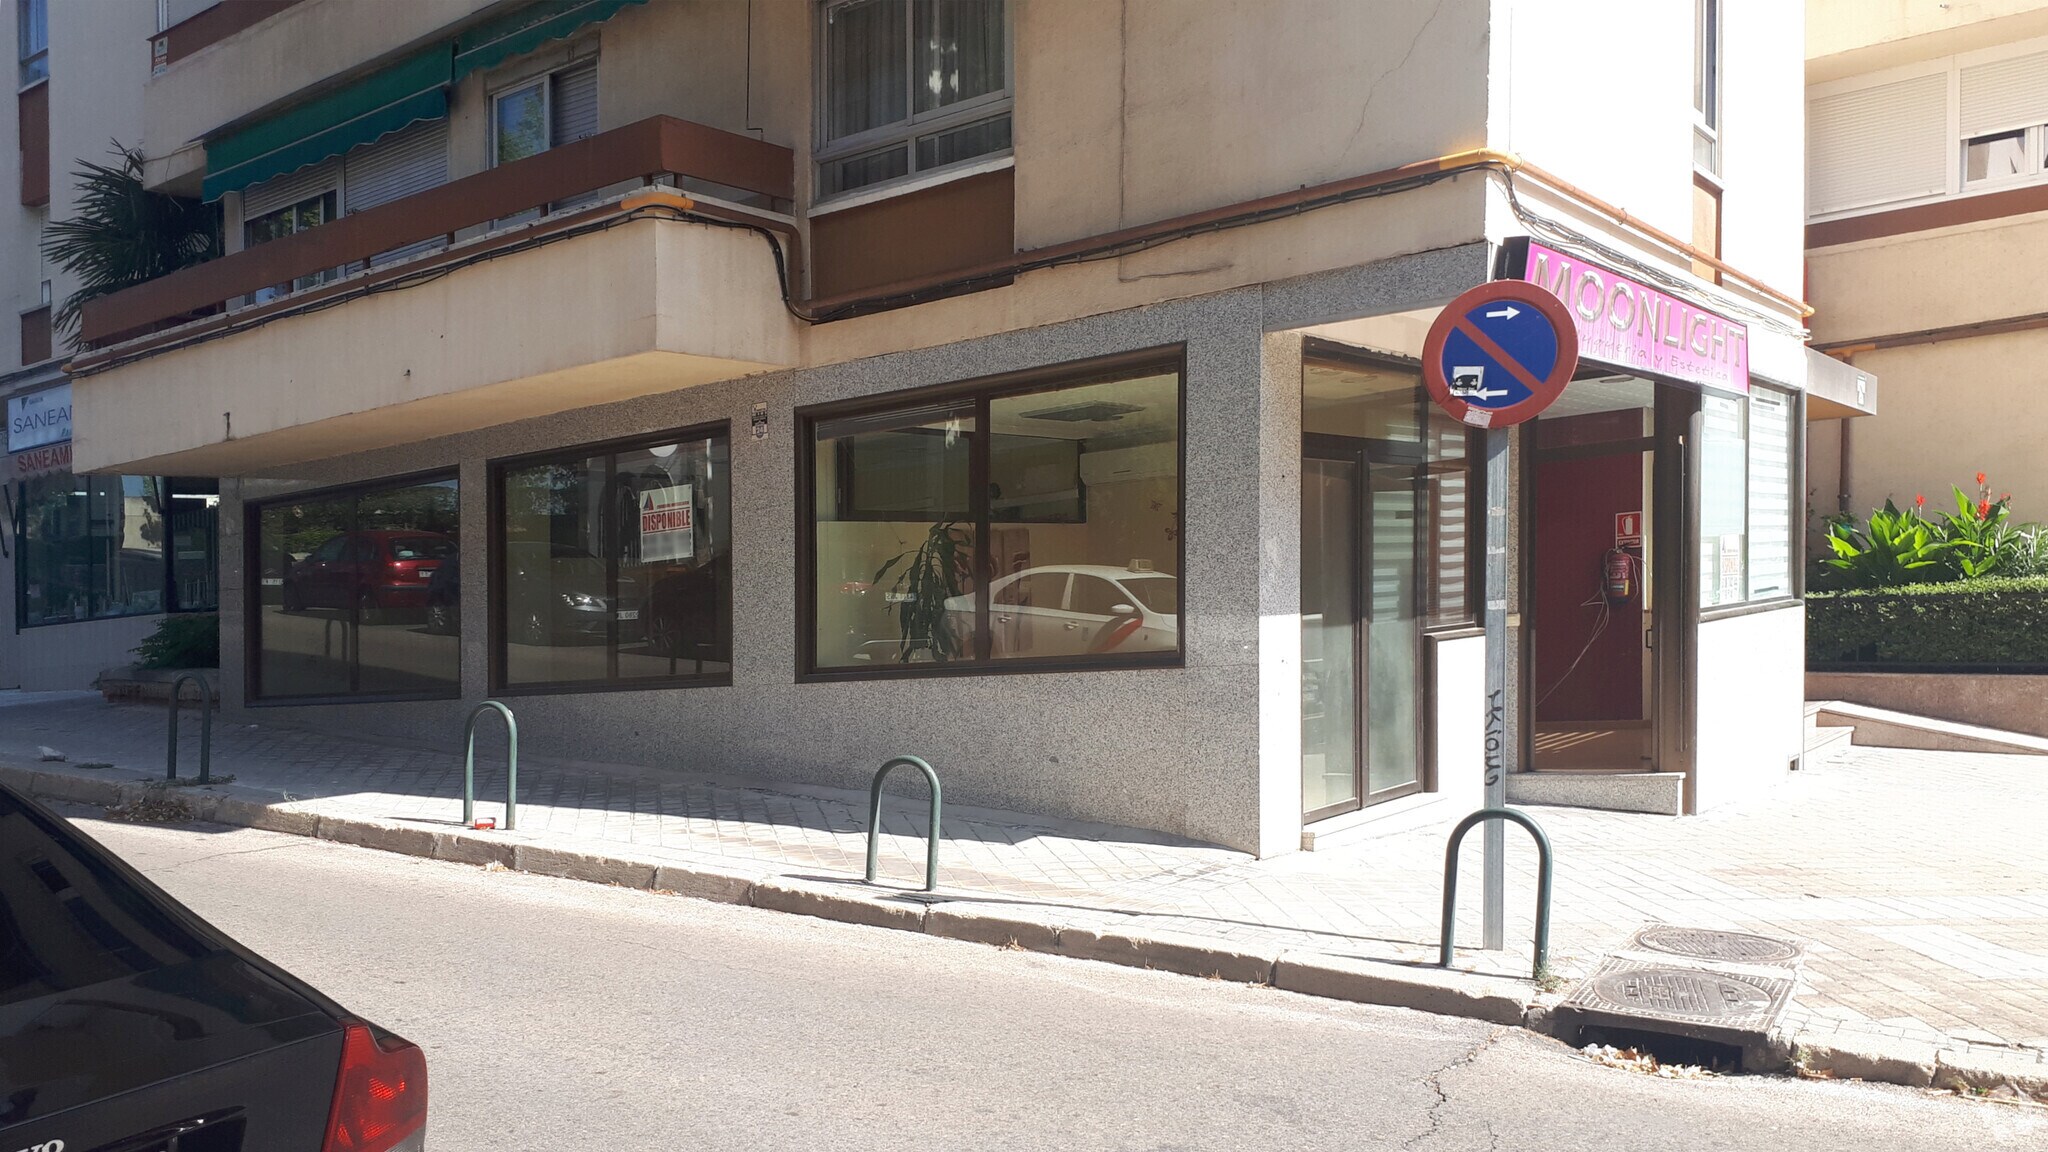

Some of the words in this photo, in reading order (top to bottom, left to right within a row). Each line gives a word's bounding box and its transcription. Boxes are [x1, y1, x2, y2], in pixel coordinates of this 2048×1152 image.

[1531, 252, 1745, 368] MOONLIGHT
[13, 404, 72, 434] SANEA
[642, 509, 691, 532] DISPONIBLE
